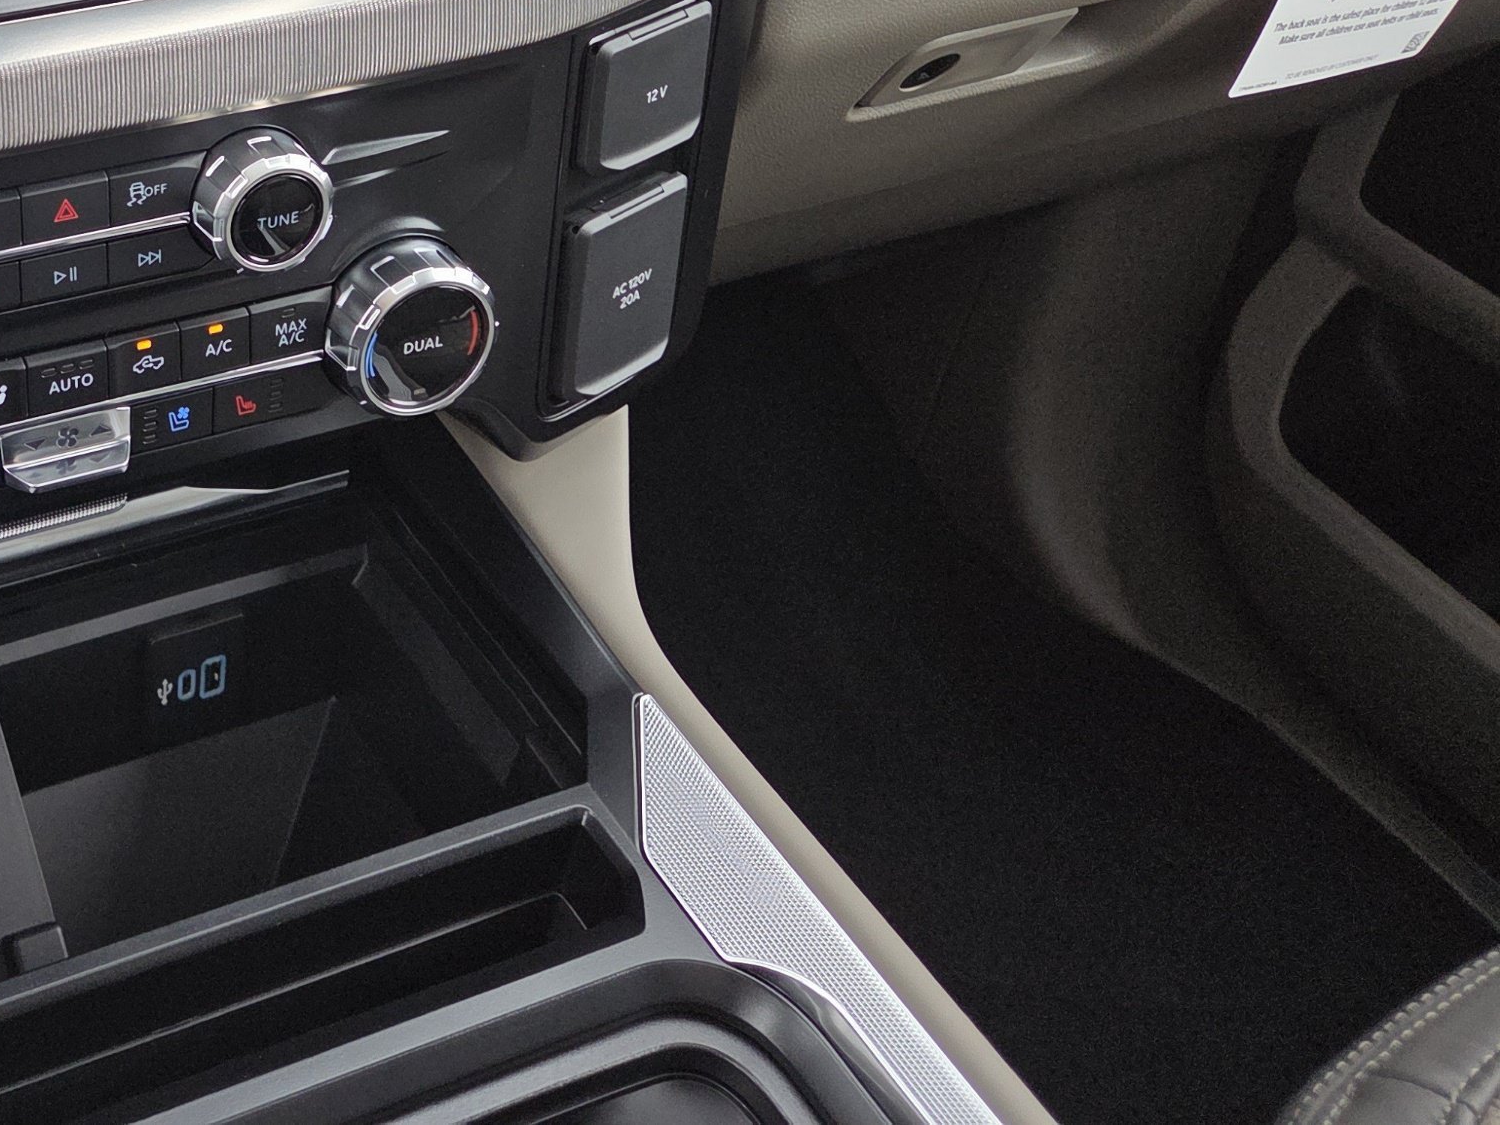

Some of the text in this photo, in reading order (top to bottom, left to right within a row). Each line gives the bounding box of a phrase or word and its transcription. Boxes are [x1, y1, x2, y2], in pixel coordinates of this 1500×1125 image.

[143, 182, 168, 197] OFF
[257, 211, 299, 228] TUNE
[612, 269, 653, 299] AC 120V
[619, 290, 641, 309] 20A
[275, 319, 308, 335] MAX
[278, 329, 305, 347] A/C
[403, 336, 443, 355] DUAL
[205, 338, 233, 358] A/C
[49, 373, 94, 395] AUTO
